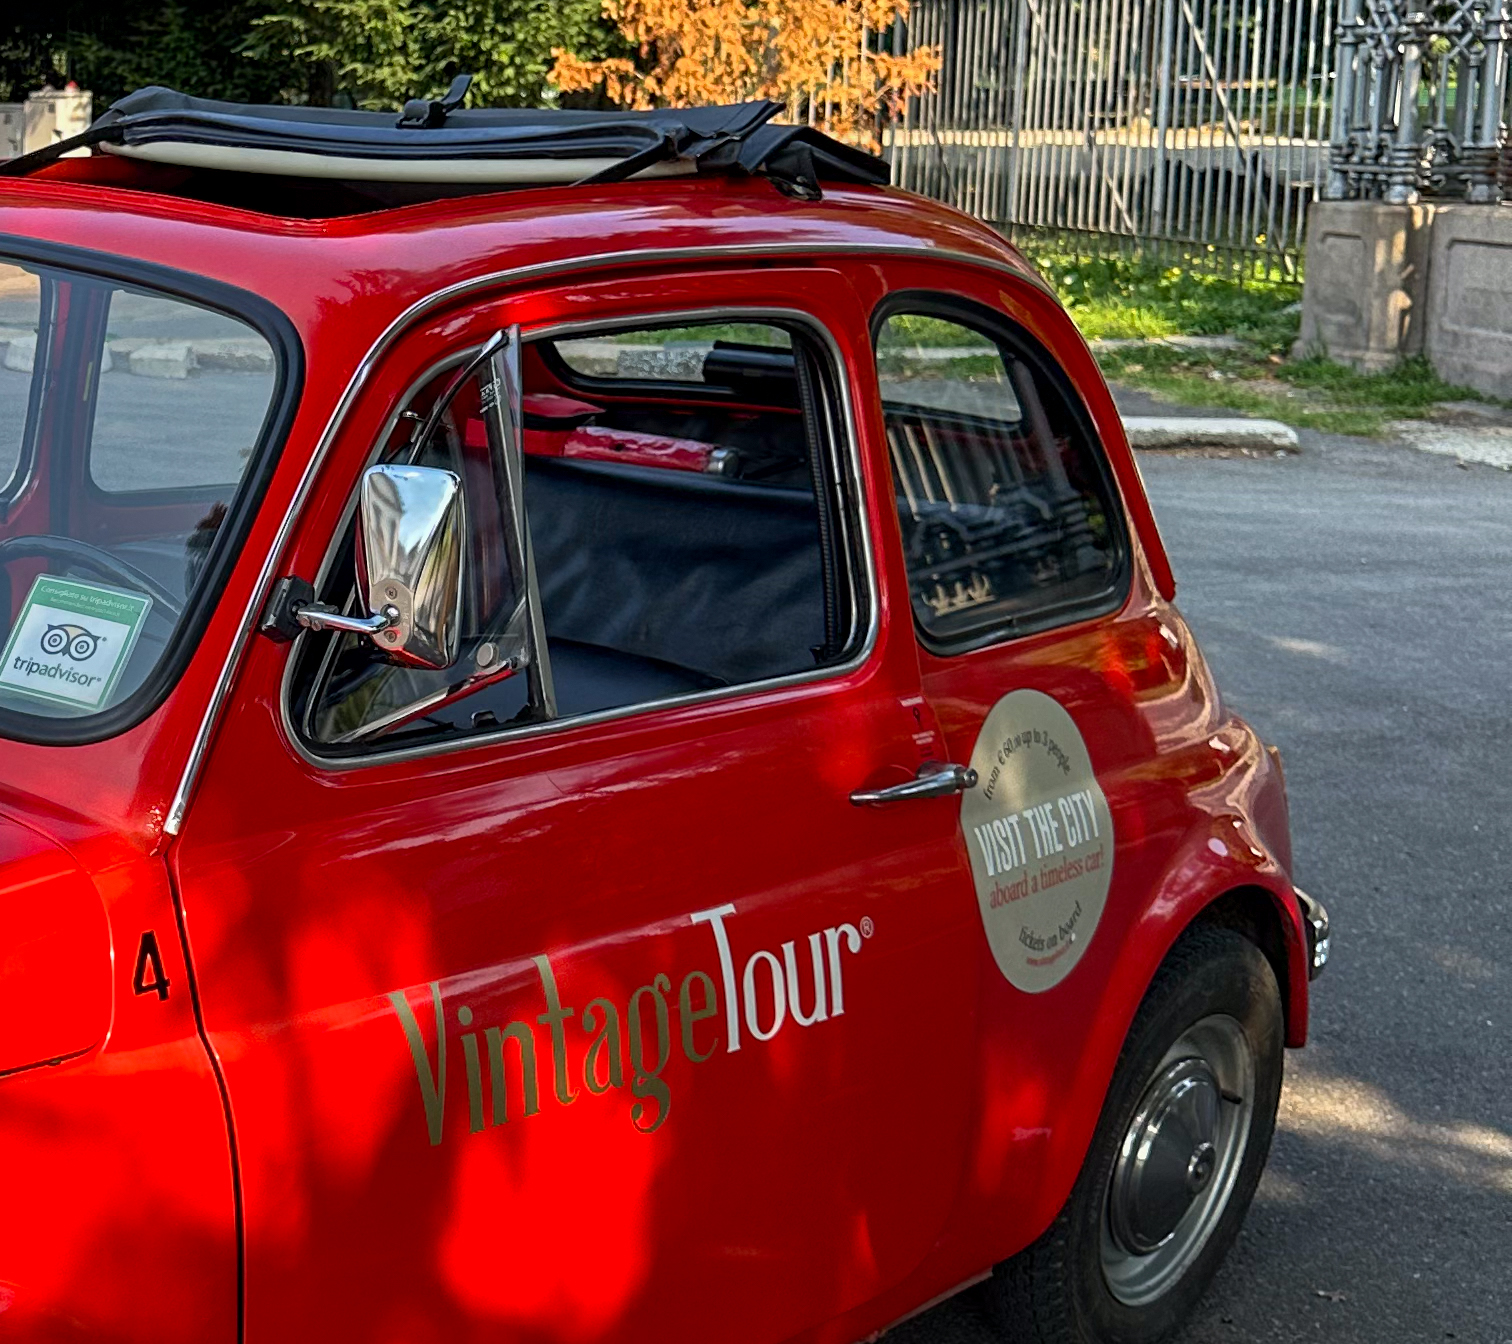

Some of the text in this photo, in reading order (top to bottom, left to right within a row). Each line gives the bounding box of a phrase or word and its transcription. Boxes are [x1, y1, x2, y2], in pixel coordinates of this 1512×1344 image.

[974, 789, 1099, 877] VISIT THE CITY
[990, 843, 1105, 910] aboard a timeless car!
[133, 929, 171, 1002] 4
